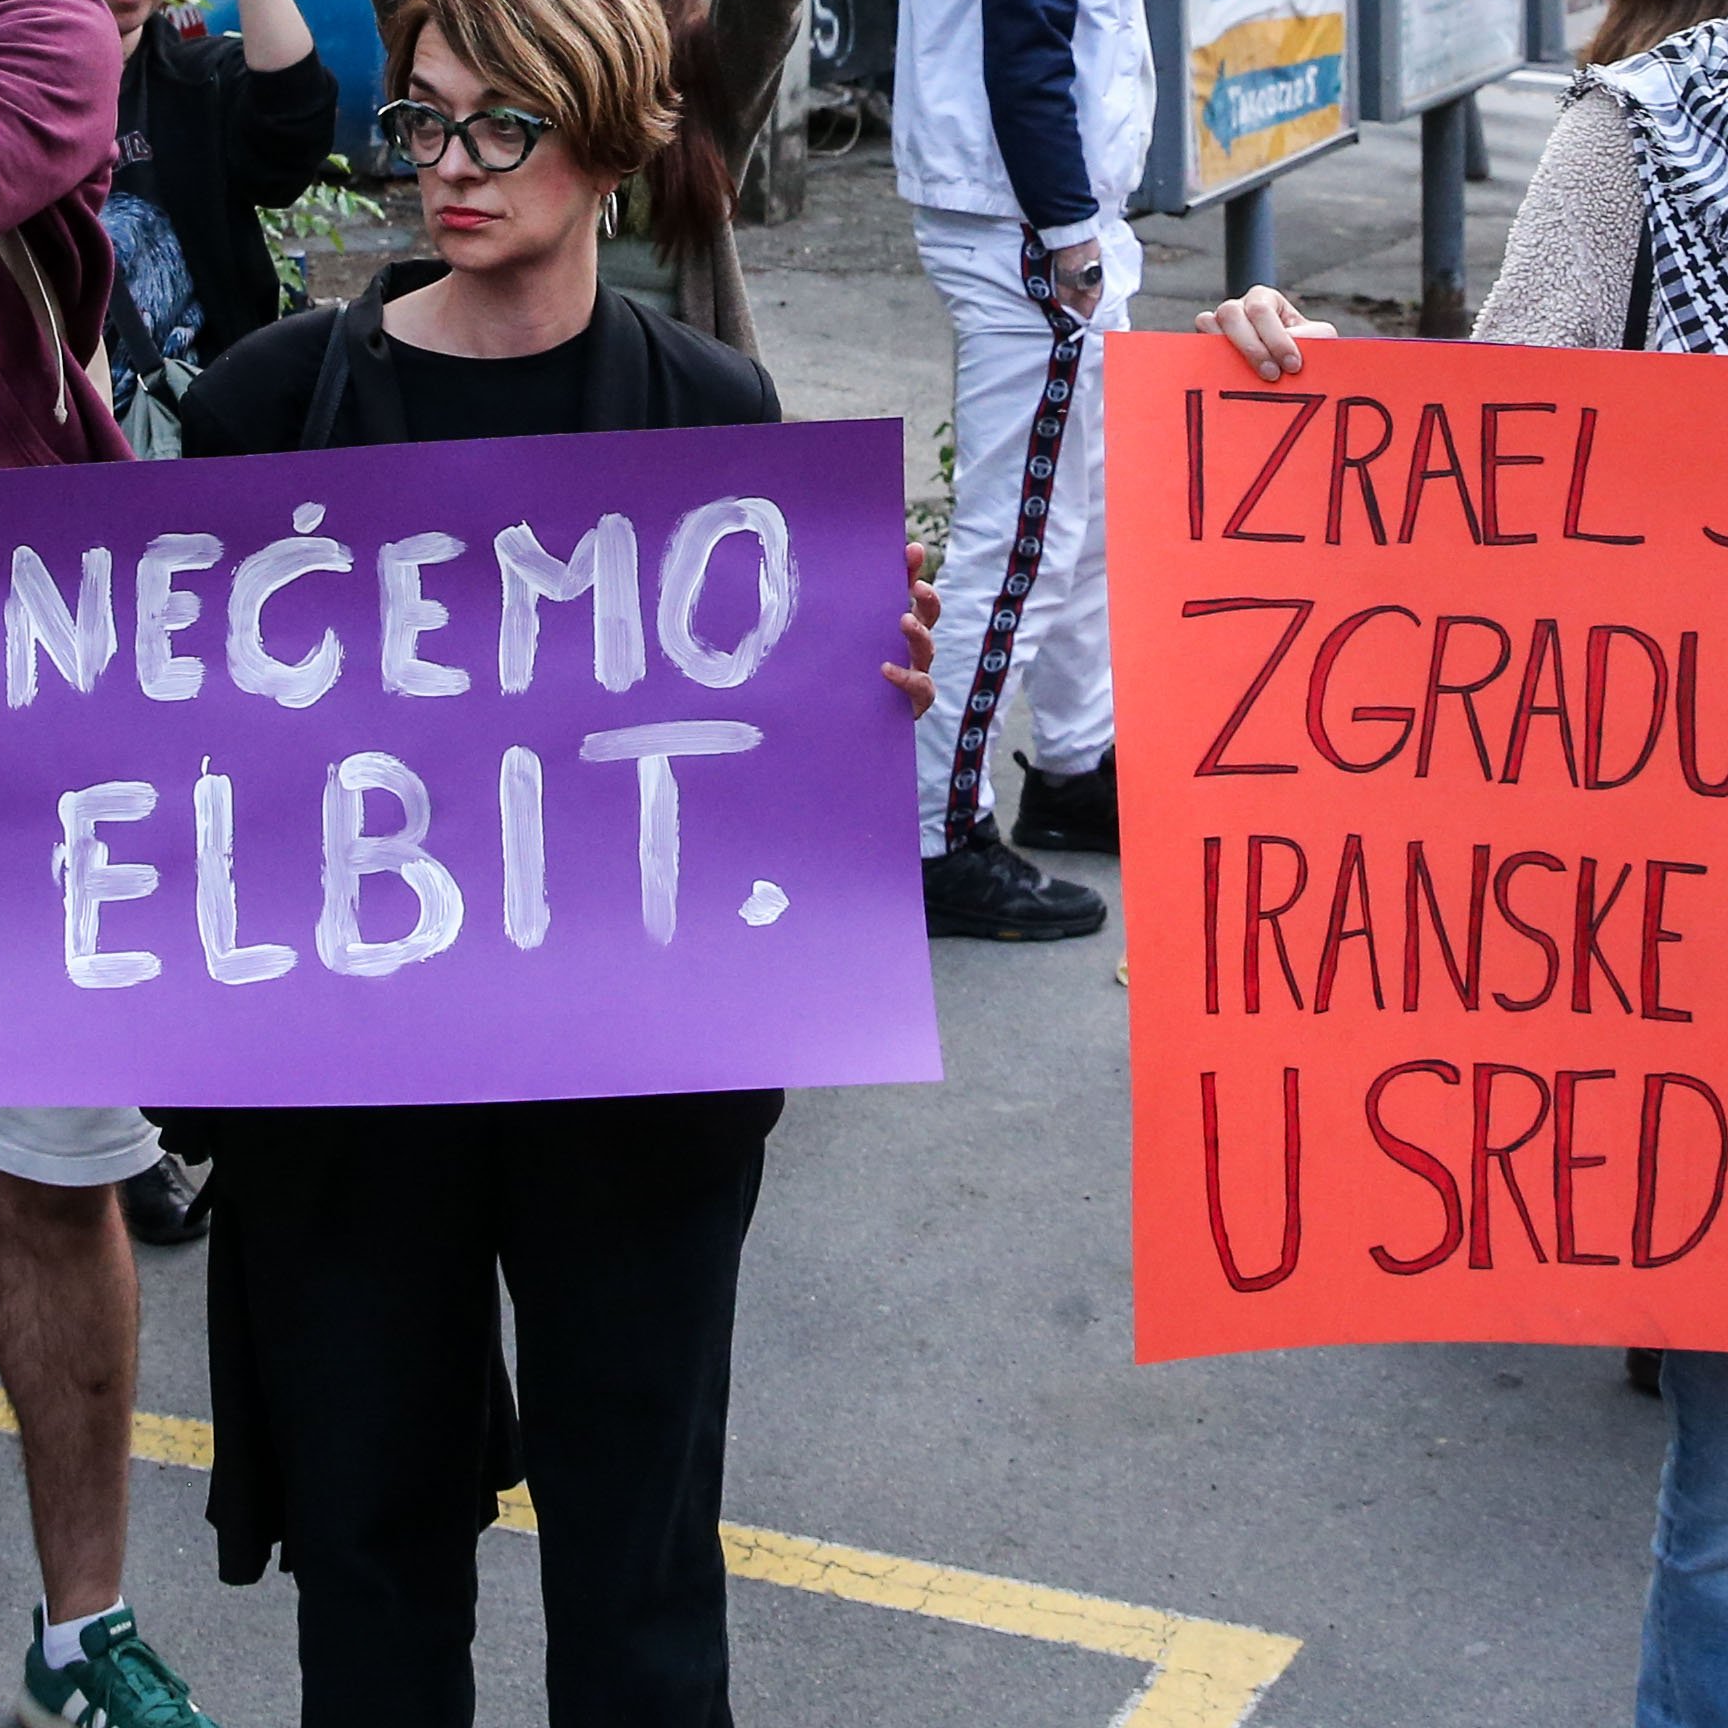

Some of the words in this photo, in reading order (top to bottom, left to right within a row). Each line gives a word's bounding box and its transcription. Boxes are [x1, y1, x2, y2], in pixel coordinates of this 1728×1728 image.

[1185, 389, 1646, 546] IZRAEL
[4, 496, 801, 709] NEĆEMO
[51, 719, 791, 990] ELBIT.
[1203, 833, 1708, 1023] IRANSKE
[1200, 1067, 1302, 1293] U
